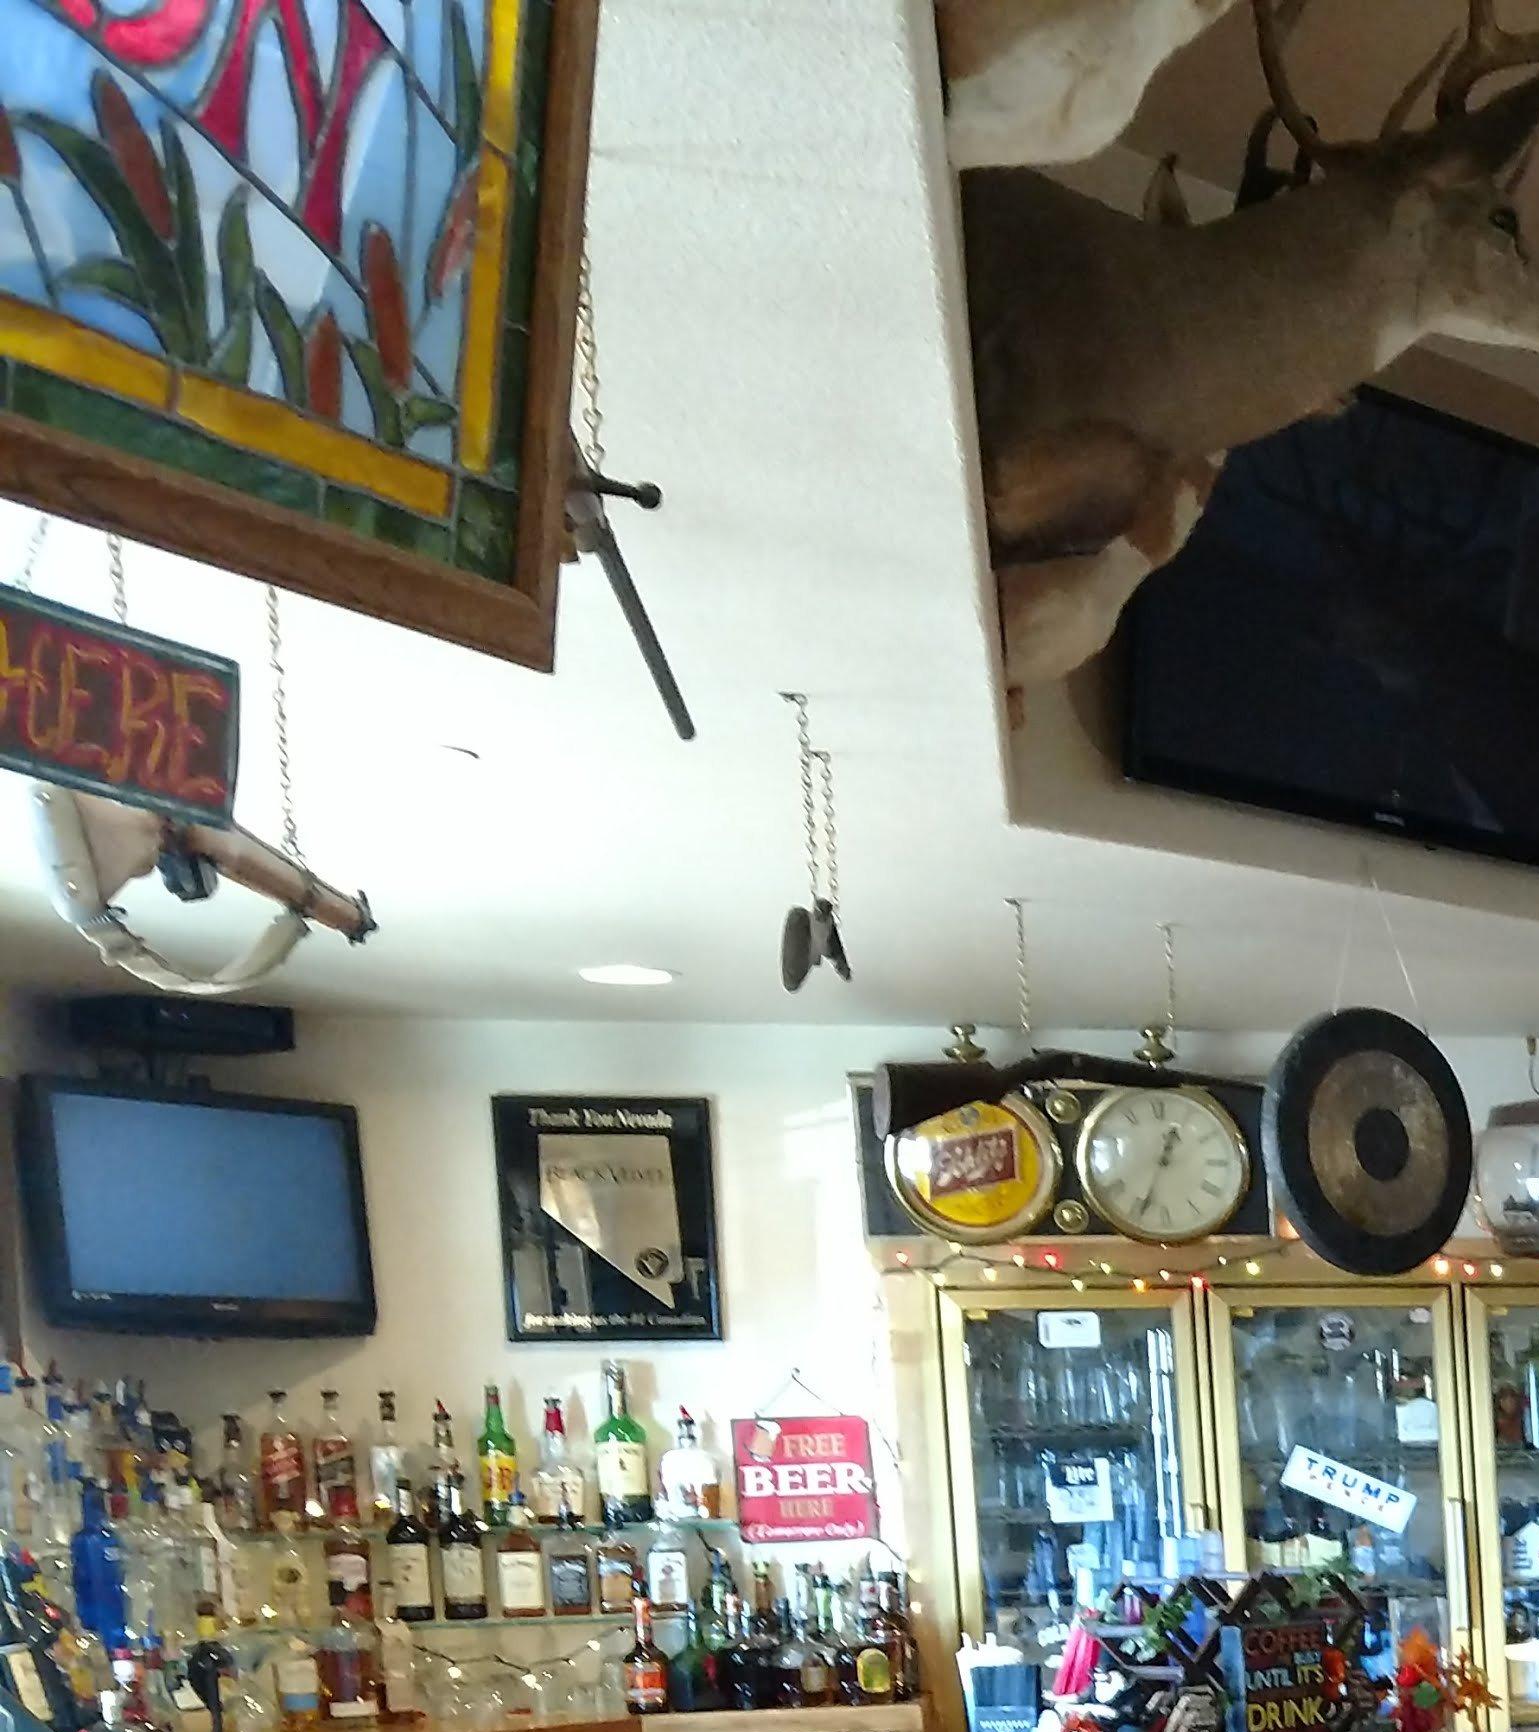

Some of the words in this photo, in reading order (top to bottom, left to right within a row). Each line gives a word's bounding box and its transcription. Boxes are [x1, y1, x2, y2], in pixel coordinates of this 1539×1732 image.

[781, 1432, 845, 1458] FREE
[738, 1462, 873, 1498] BEER
[1305, 1457, 1400, 1504] TRUMP
[1247, 1695, 1326, 1732] DRINK
